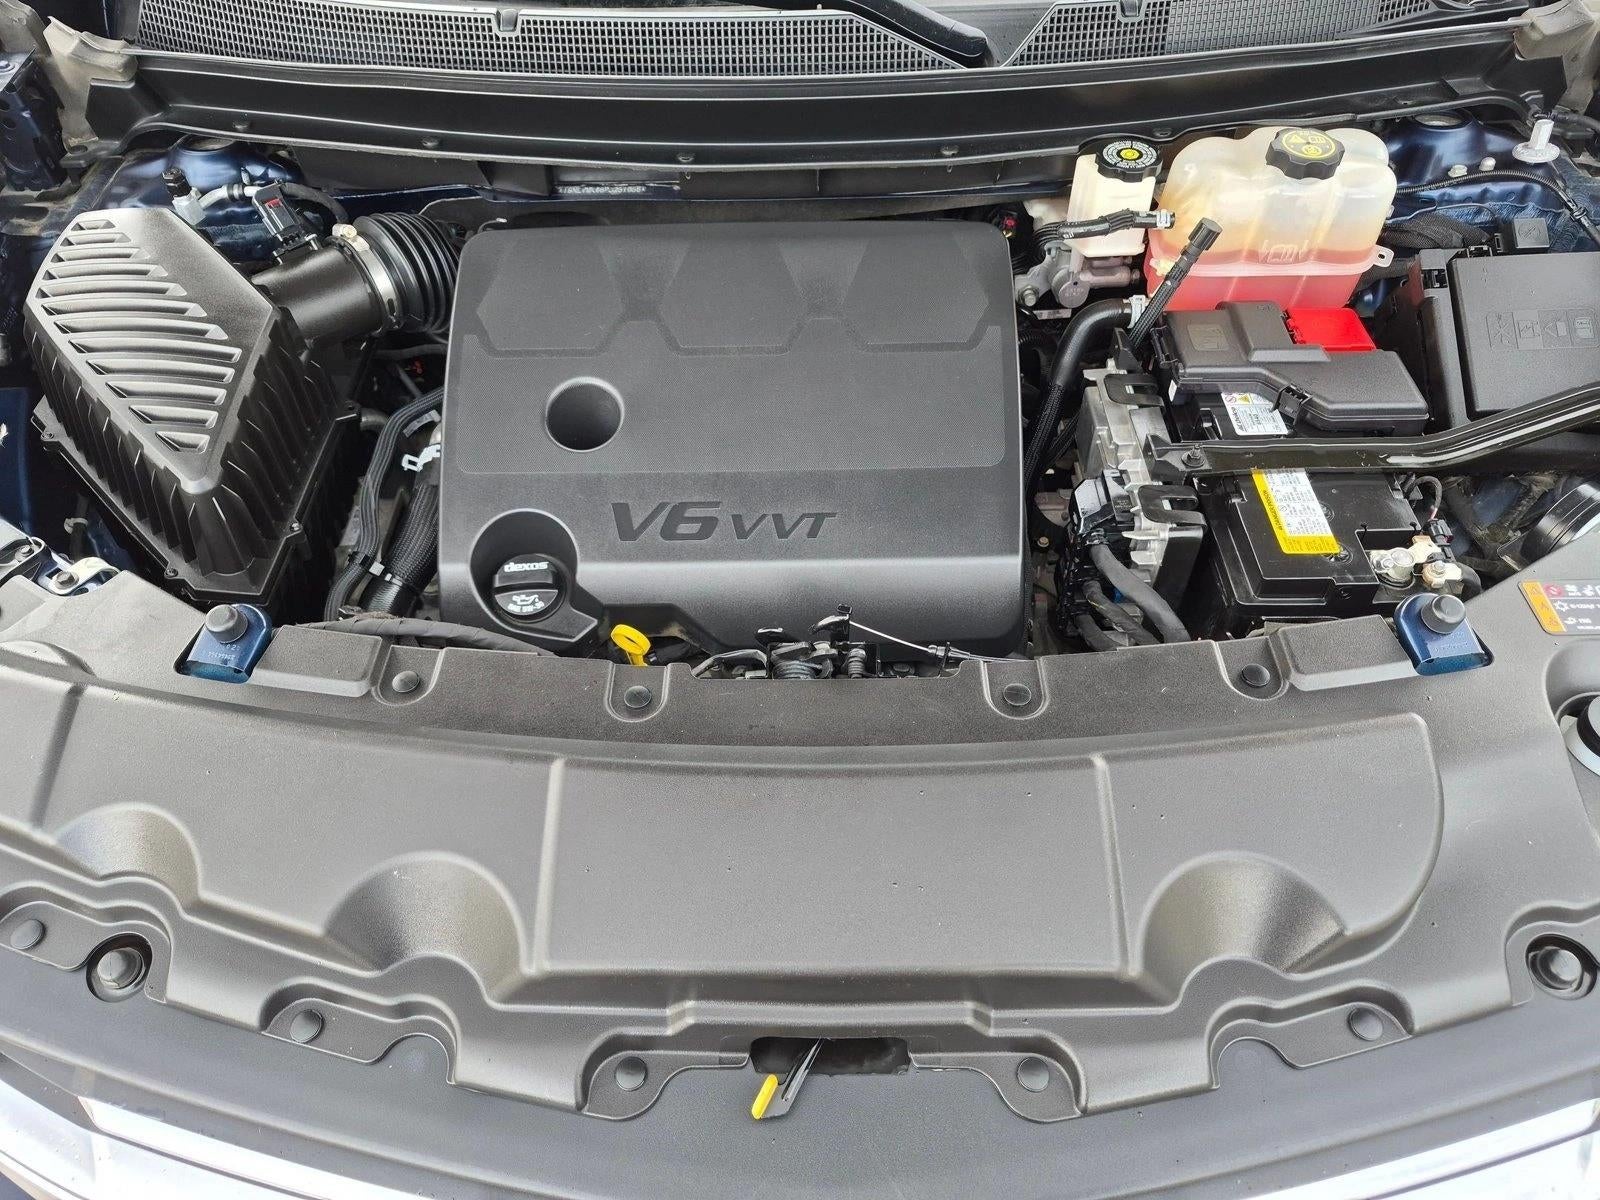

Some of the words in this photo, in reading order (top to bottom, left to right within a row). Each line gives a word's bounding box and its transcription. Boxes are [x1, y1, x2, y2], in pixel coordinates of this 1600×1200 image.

[611, 501, 723, 541] V6
[731, 512, 838, 540] VVT
[504, 561, 549, 573] dexos
